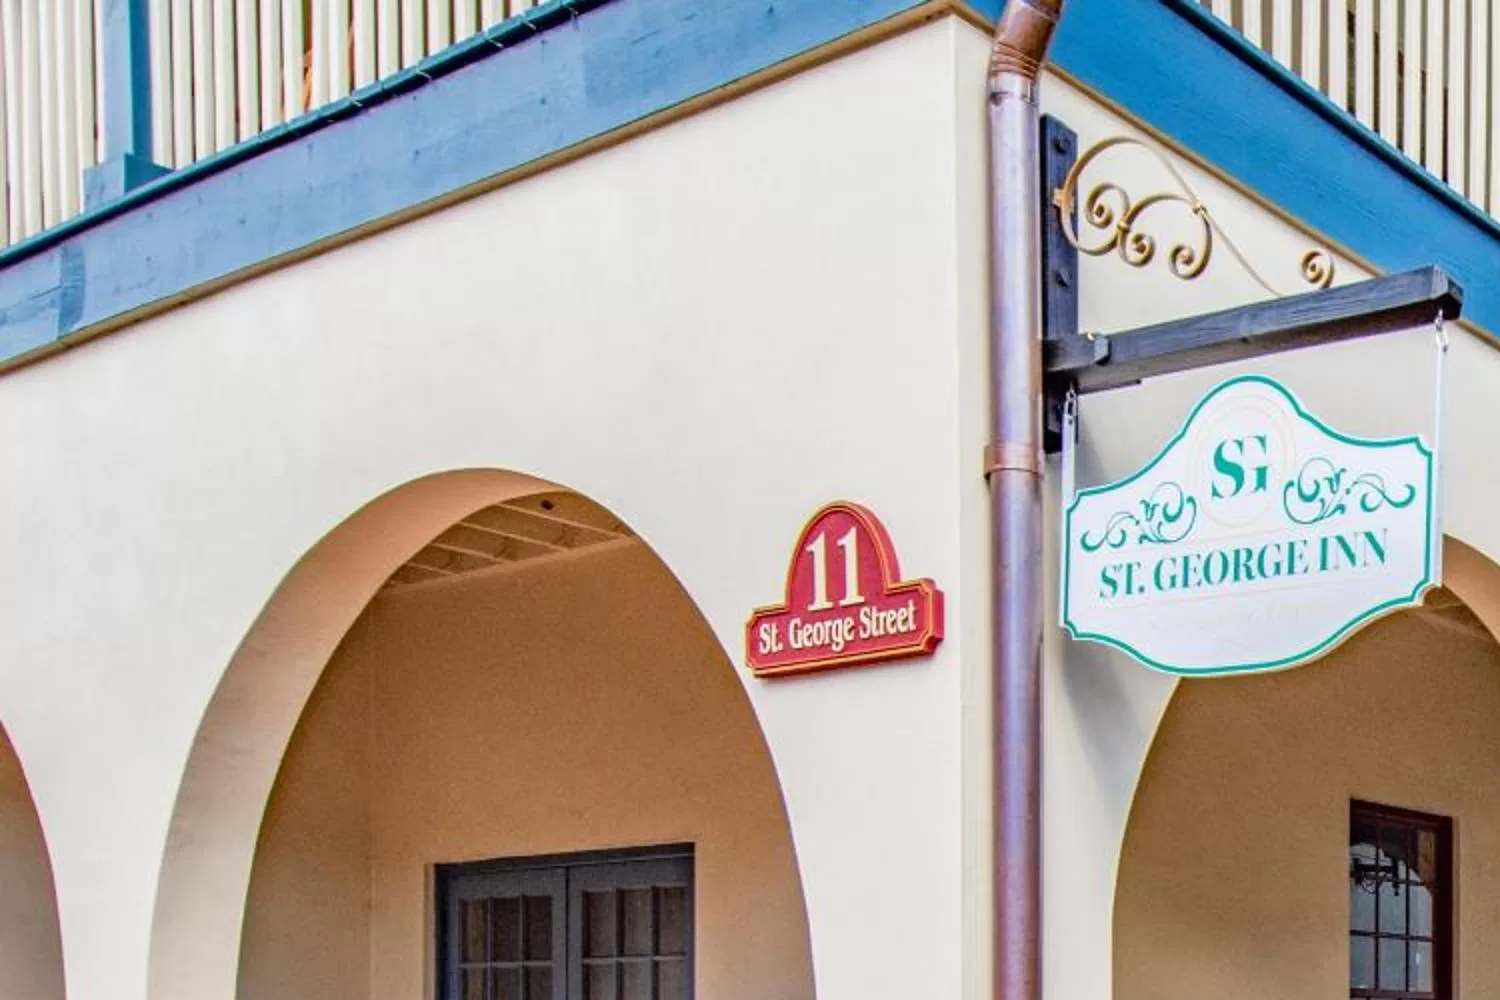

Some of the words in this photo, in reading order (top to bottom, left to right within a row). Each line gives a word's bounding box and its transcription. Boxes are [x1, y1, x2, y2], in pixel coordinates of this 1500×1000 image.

[805, 526, 865, 611] 11
[1099, 562, 1146, 599] ST.
[1153, 540, 1309, 592] GEORGE
[1318, 527, 1388, 571] INN
[759, 623, 783, 655] St.
[789, 616, 855, 652] George
[859, 600, 916, 639] Street
